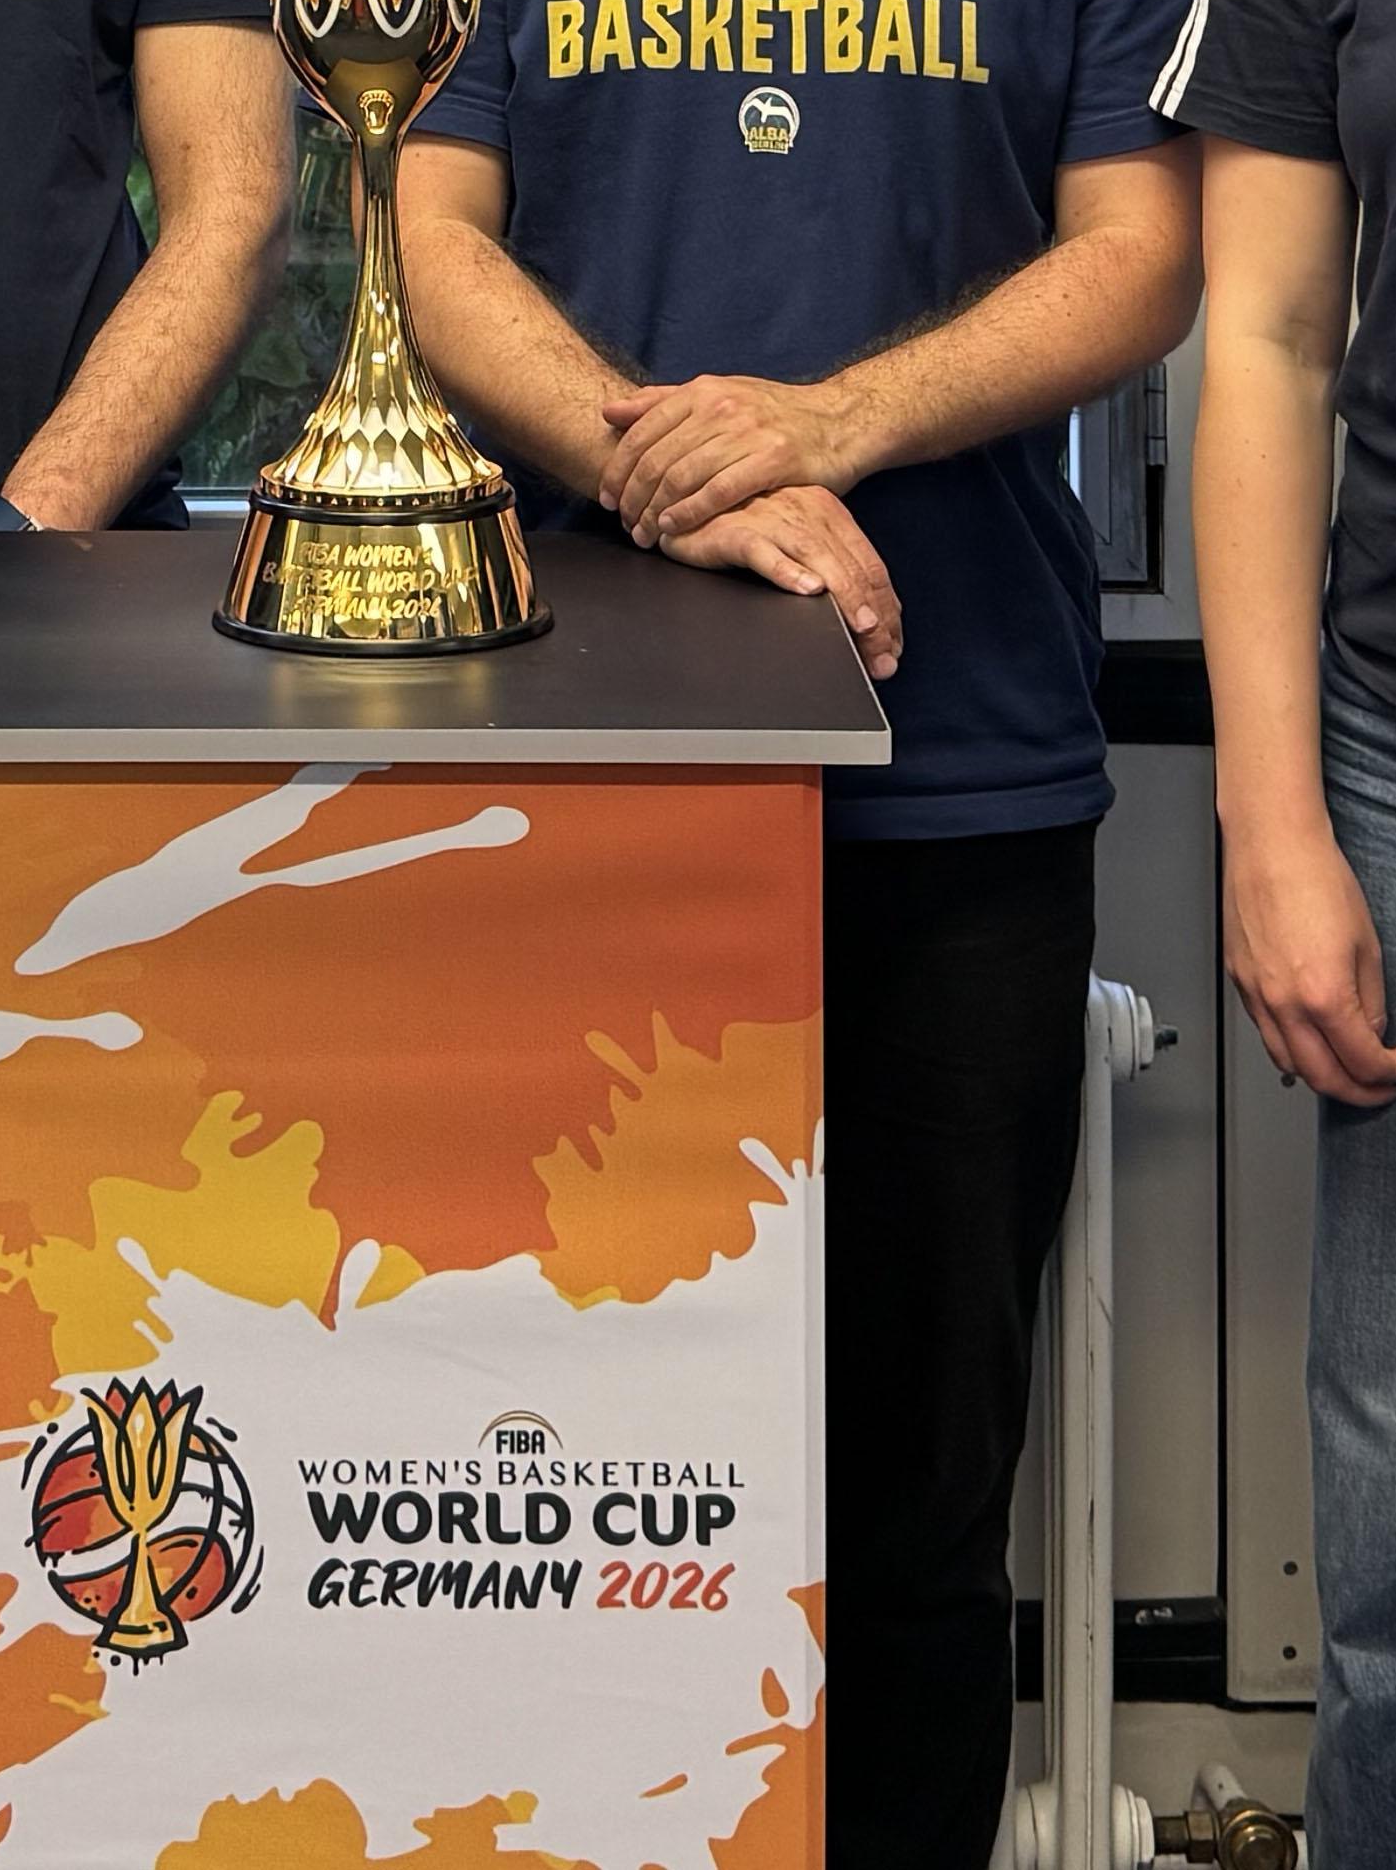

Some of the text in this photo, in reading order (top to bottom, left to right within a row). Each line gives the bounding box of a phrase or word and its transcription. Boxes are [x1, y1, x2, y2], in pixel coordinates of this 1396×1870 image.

[749, 126, 789, 143] ALBA
[495, 1429, 546, 1455] FIBA
[298, 1459, 746, 1488] WOMEN'S BASKETBALL
[306, 1490, 737, 1547] WORLD CUP
[307, 1557, 737, 1612] GERMANY 2026
